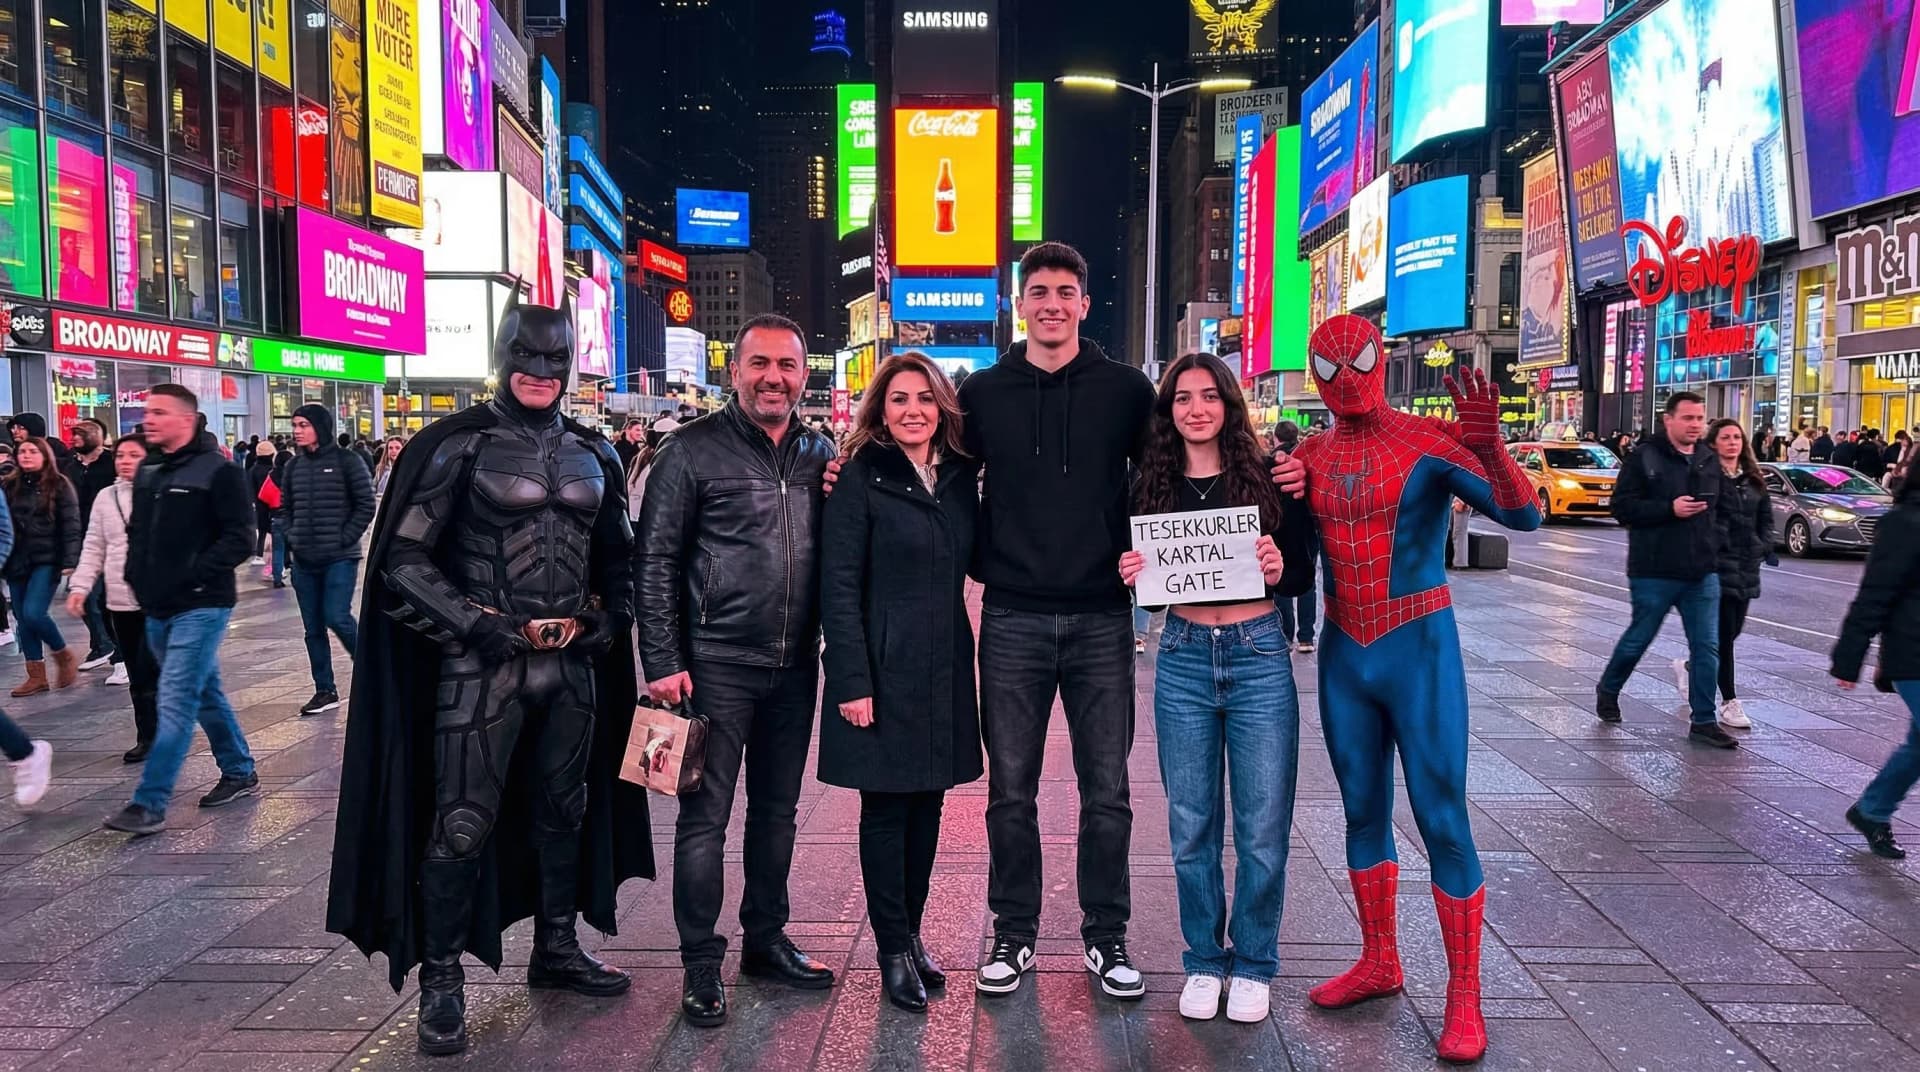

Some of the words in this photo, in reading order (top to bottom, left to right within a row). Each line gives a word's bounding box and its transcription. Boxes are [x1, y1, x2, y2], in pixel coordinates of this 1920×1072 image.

[903, 11, 988, 27] SAMSUNG
[374, 23, 413, 71] VOTER
[324, 250, 408, 314] BROADWAY
[905, 292, 984, 307] SAMSUNG
[59, 317, 171, 356] BROADWAY
[1134, 513, 1260, 541] TESEKKURLER
[1157, 543, 1235, 567] KARTAL
[1166, 570, 1226, 595] GATE
